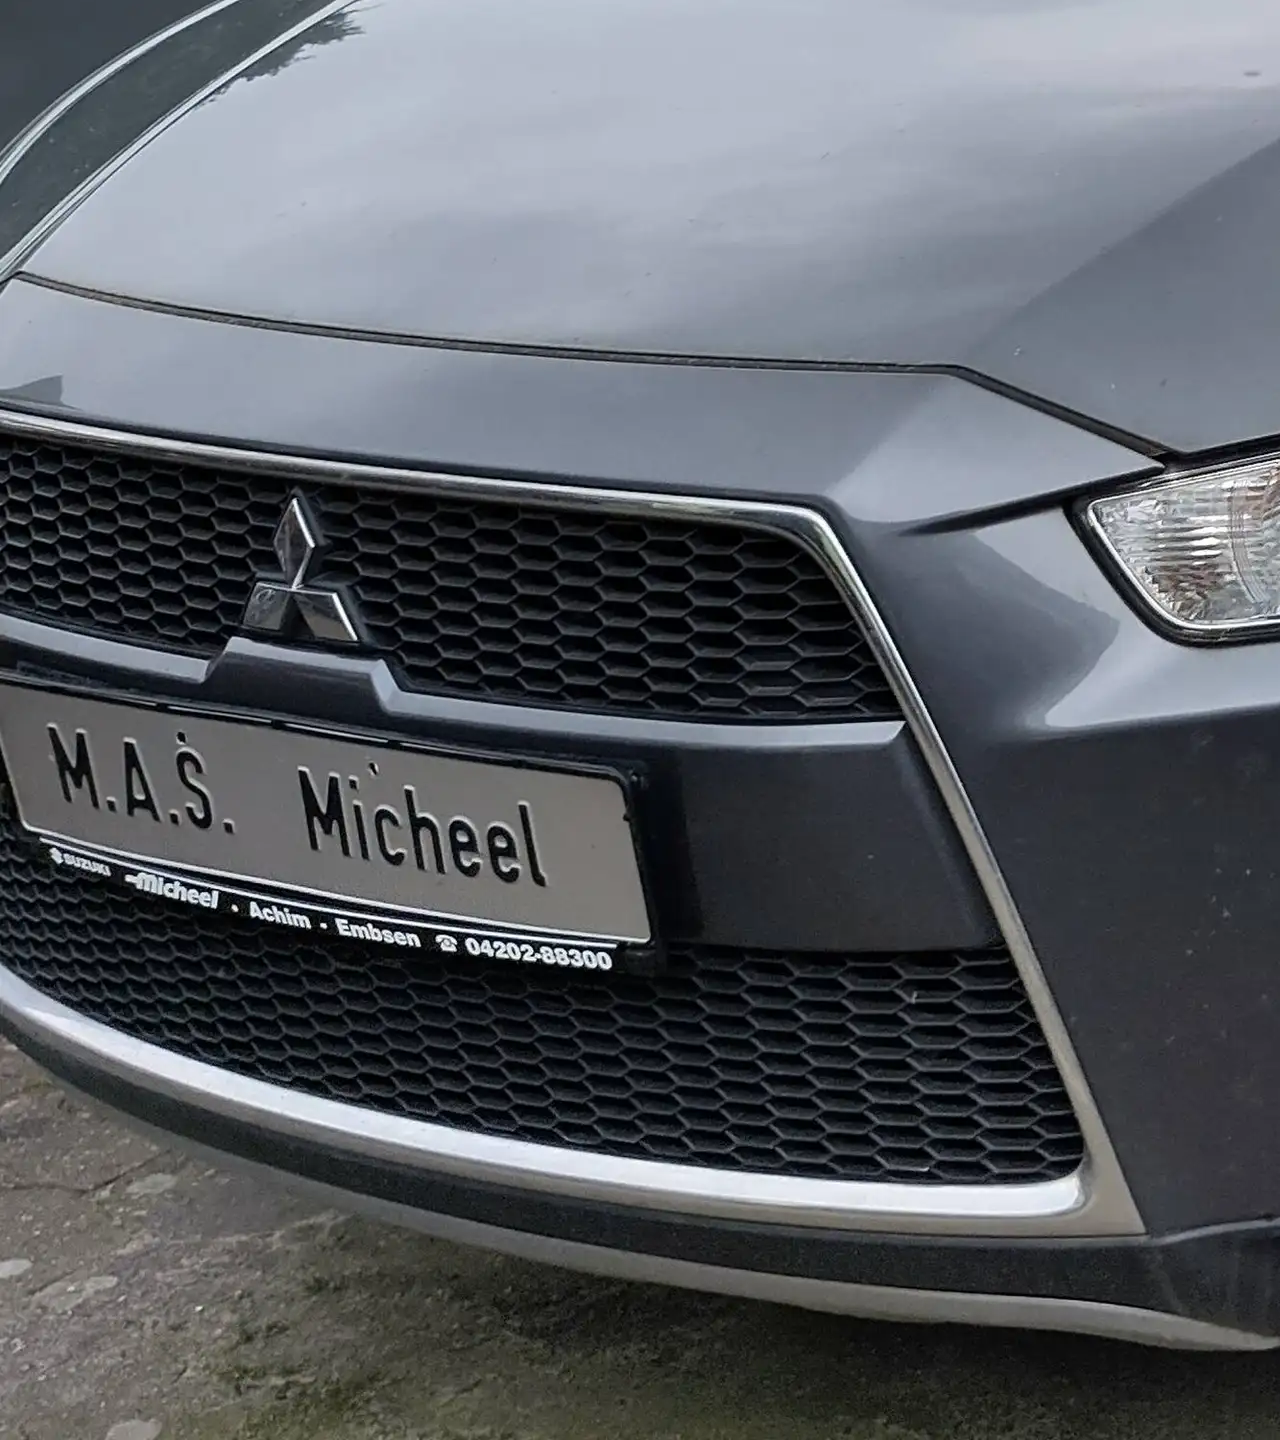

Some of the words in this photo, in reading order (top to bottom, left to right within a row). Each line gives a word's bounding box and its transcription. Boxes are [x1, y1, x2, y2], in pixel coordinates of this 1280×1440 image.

[46, 722, 236, 835] M.A.S.
[297, 765, 548, 888] Micheel
[63, 853, 112, 877] SUZUKI
[134, 872, 219, 909] Micheel
[250, 901, 311, 930] Achim
[334, 917, 421, 948] Embsen
[464, 937, 613, 971] 04202-88300
